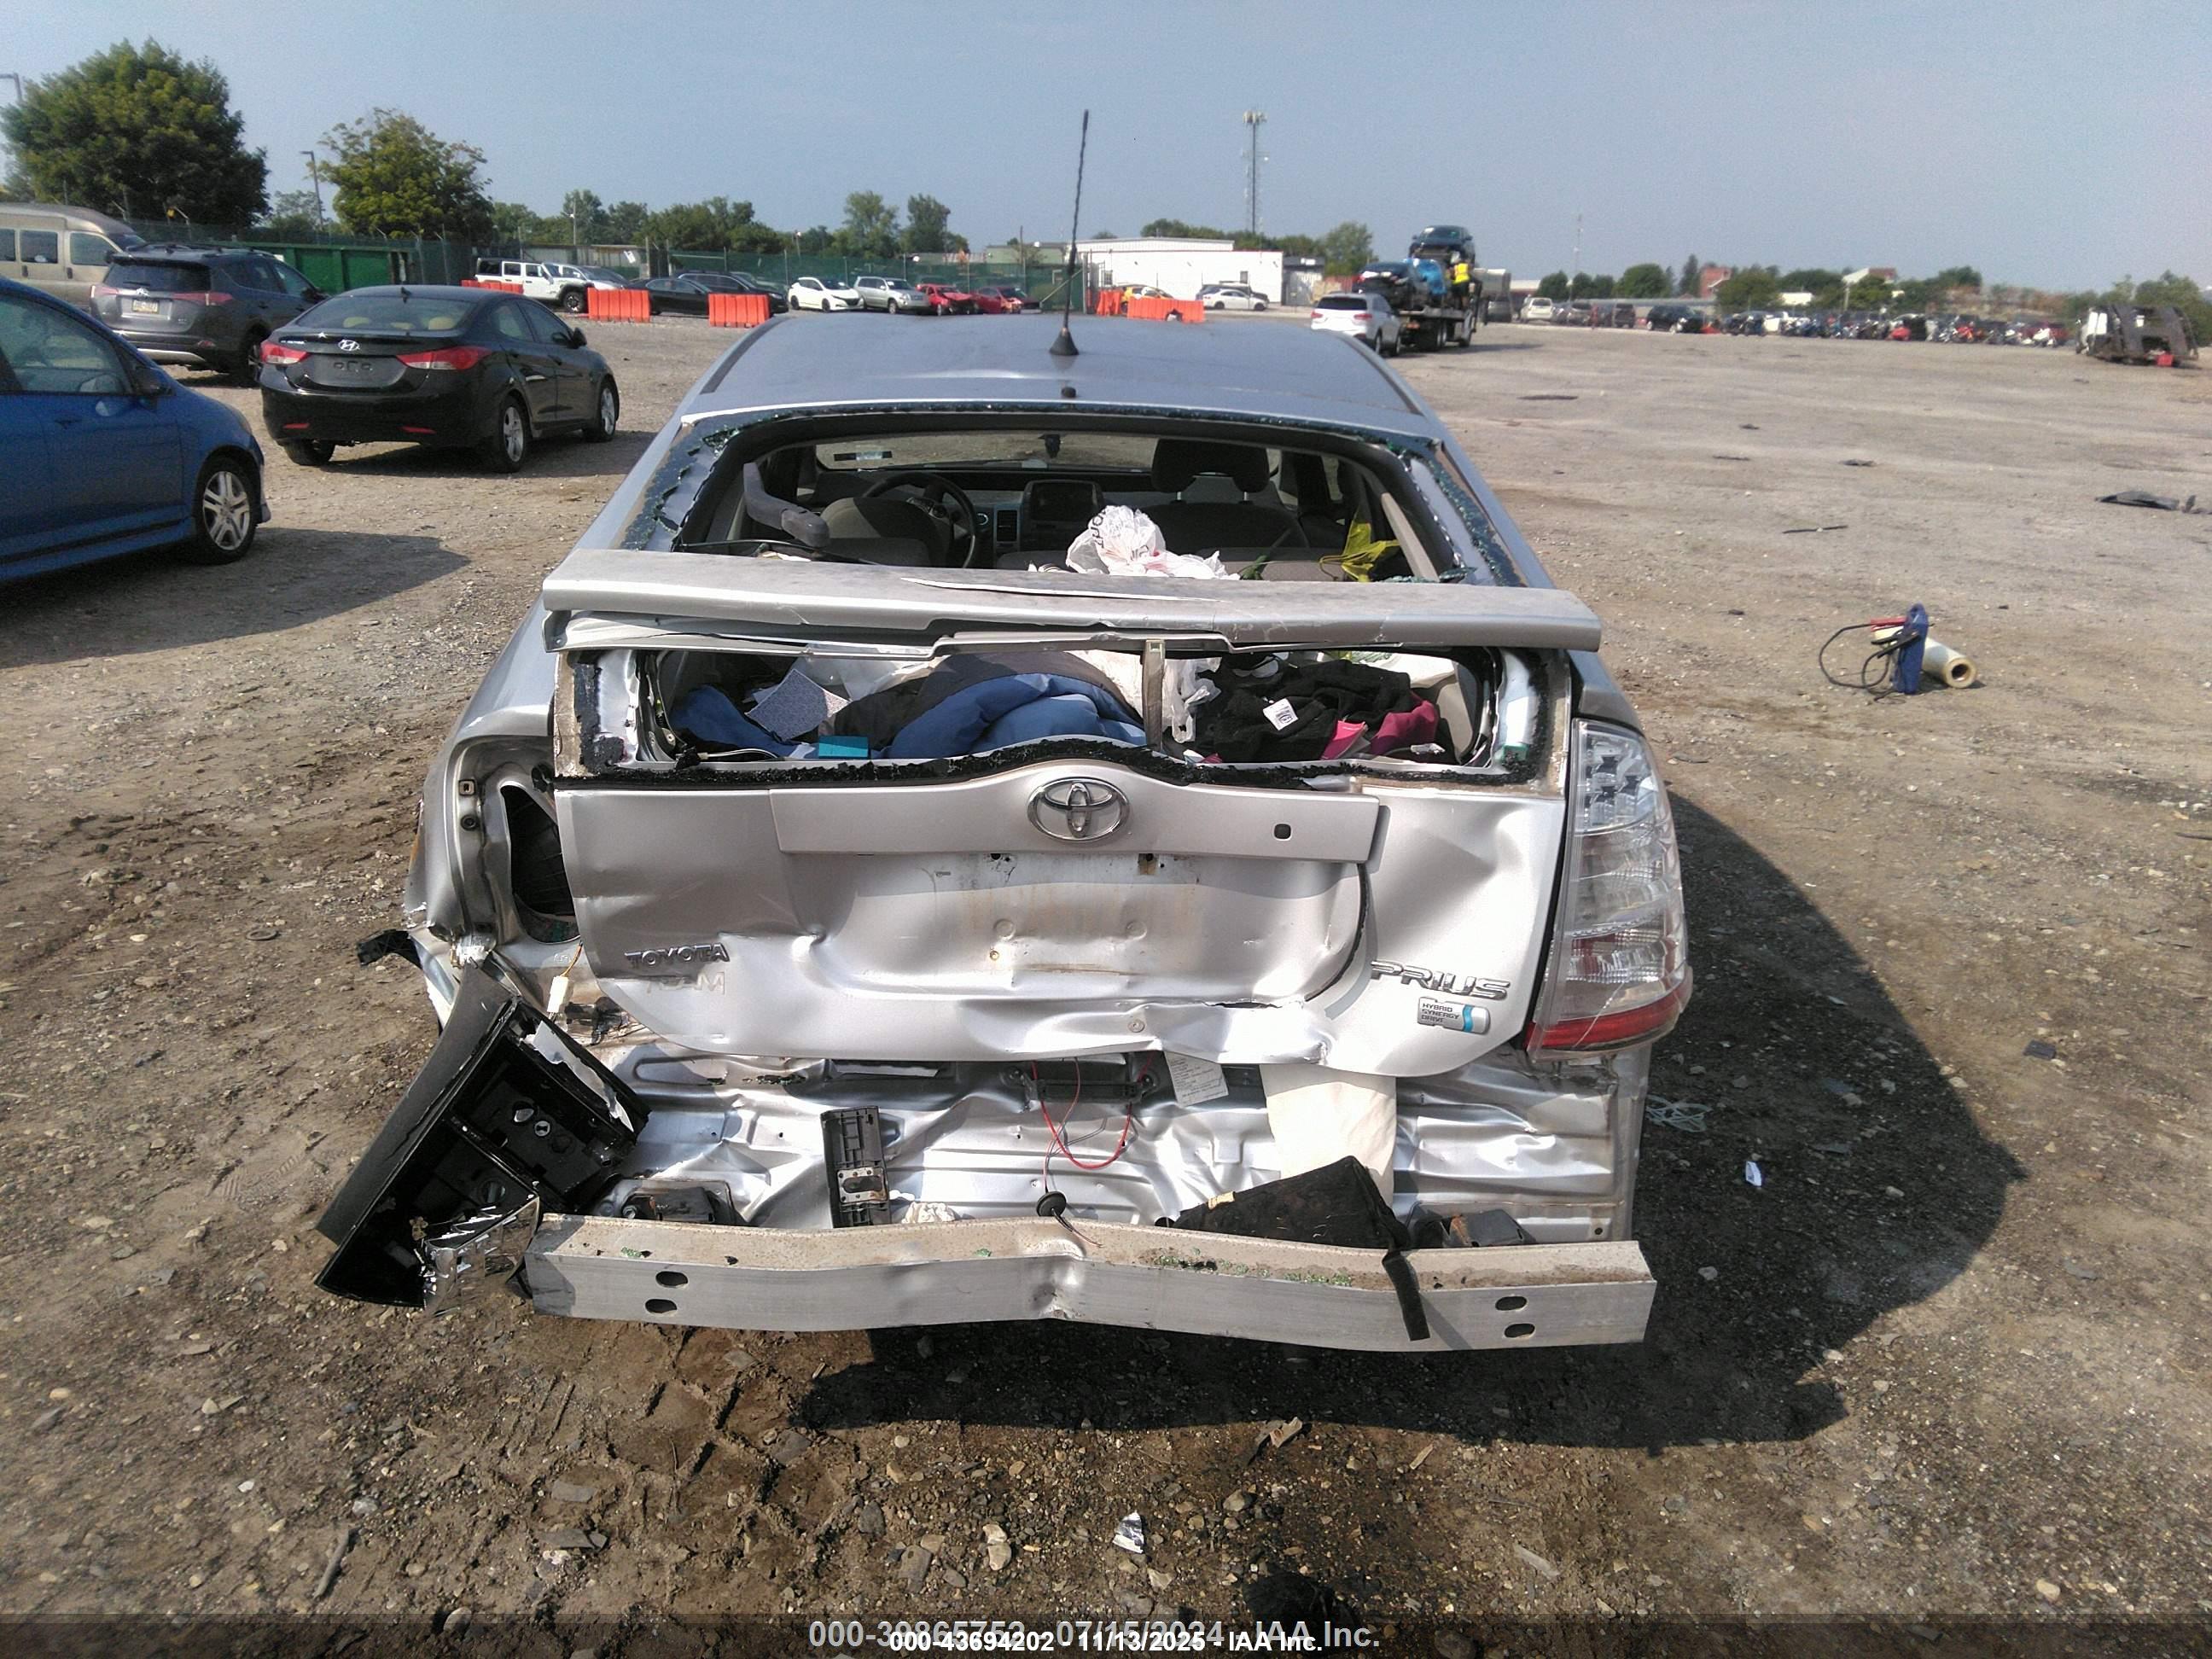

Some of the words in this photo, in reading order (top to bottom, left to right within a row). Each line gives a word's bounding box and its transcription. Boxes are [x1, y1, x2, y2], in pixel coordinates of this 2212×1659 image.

[624, 942, 730, 968] TOYOTA
[1370, 959, 1510, 1000] PRIUS
[1422, 1003, 1453, 1013] HYBRID
[1421, 1009, 1460, 1020] SYNERGY
[1421, 1014, 1446, 1023] DRIVE
